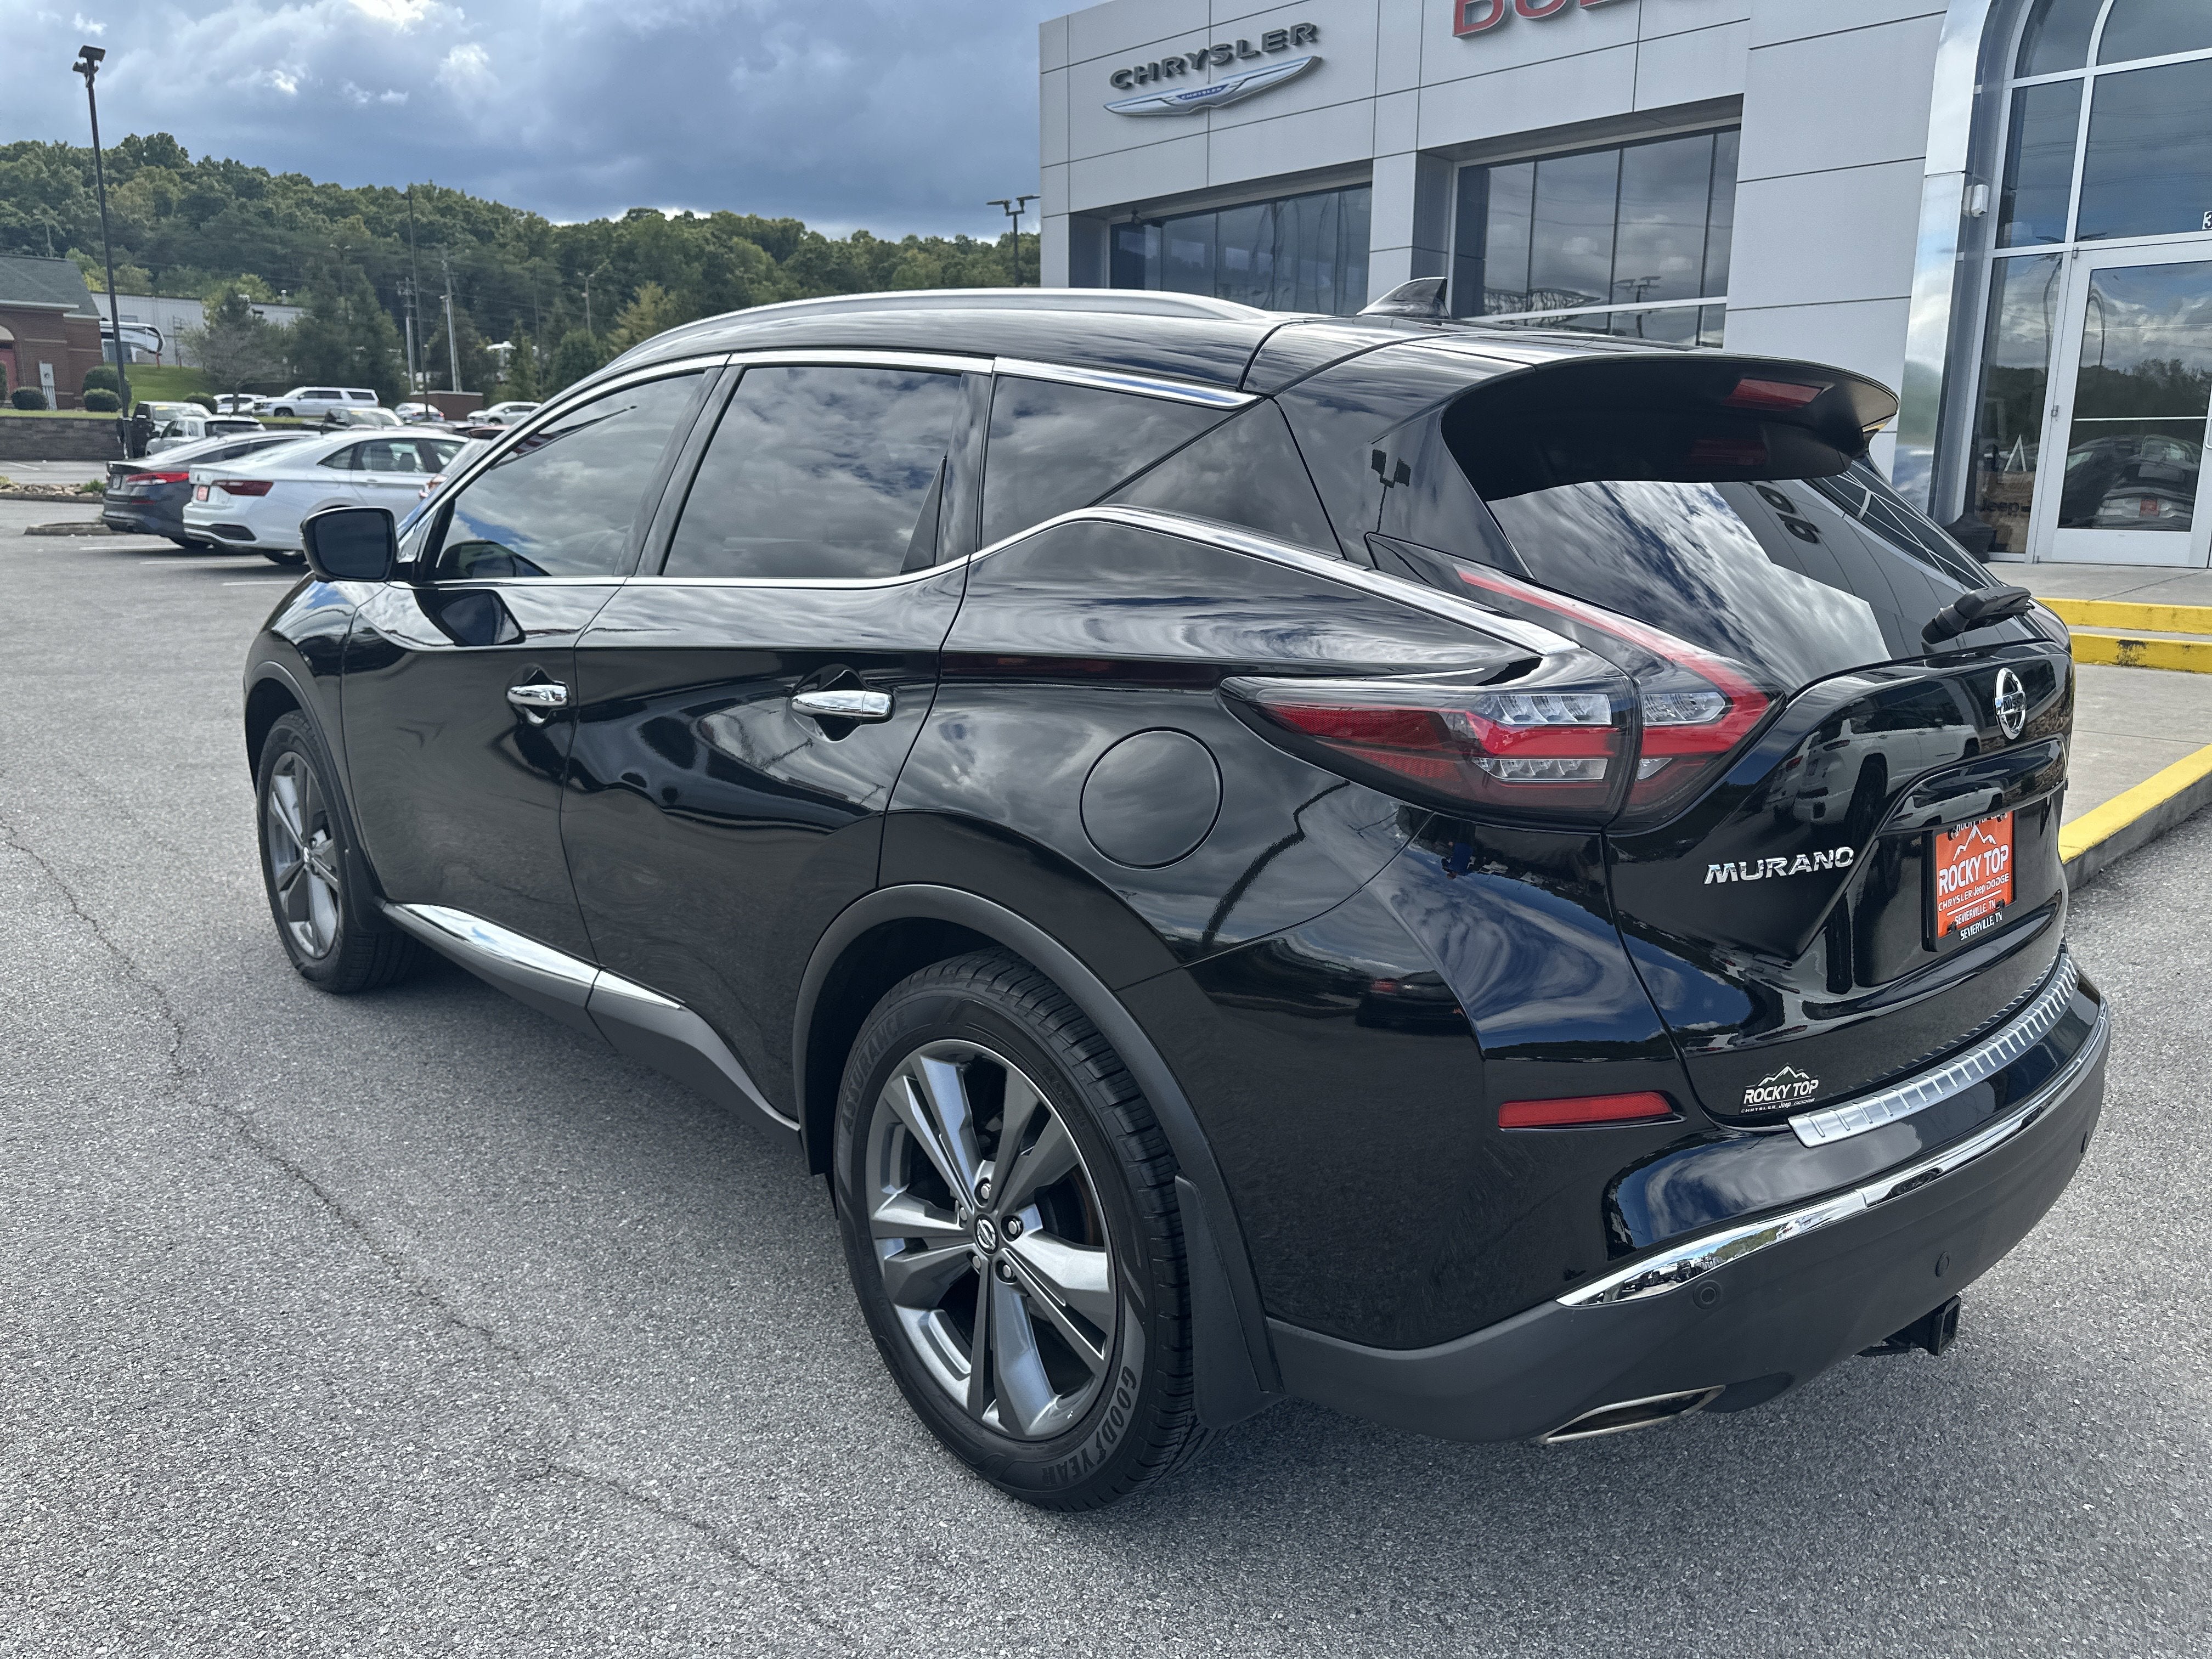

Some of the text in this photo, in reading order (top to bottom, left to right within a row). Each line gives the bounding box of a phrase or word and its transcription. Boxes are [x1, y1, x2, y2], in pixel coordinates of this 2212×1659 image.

[1109, 22, 1318, 89] CHRYSLER
[1705, 847, 1854, 884] MURANO
[1939, 844, 2008, 896] ROCKY TOP
[1938, 872, 2009, 912] CHRYSLER Jeep DODGE
[1989, 899, 1995, 910] TN
[1960, 911, 2002, 940] SEVIERVILLE, TN
[1743, 1079, 1819, 1104] ROCKY TOP
[1741, 1105, 1776, 1113] CHRYSLER
